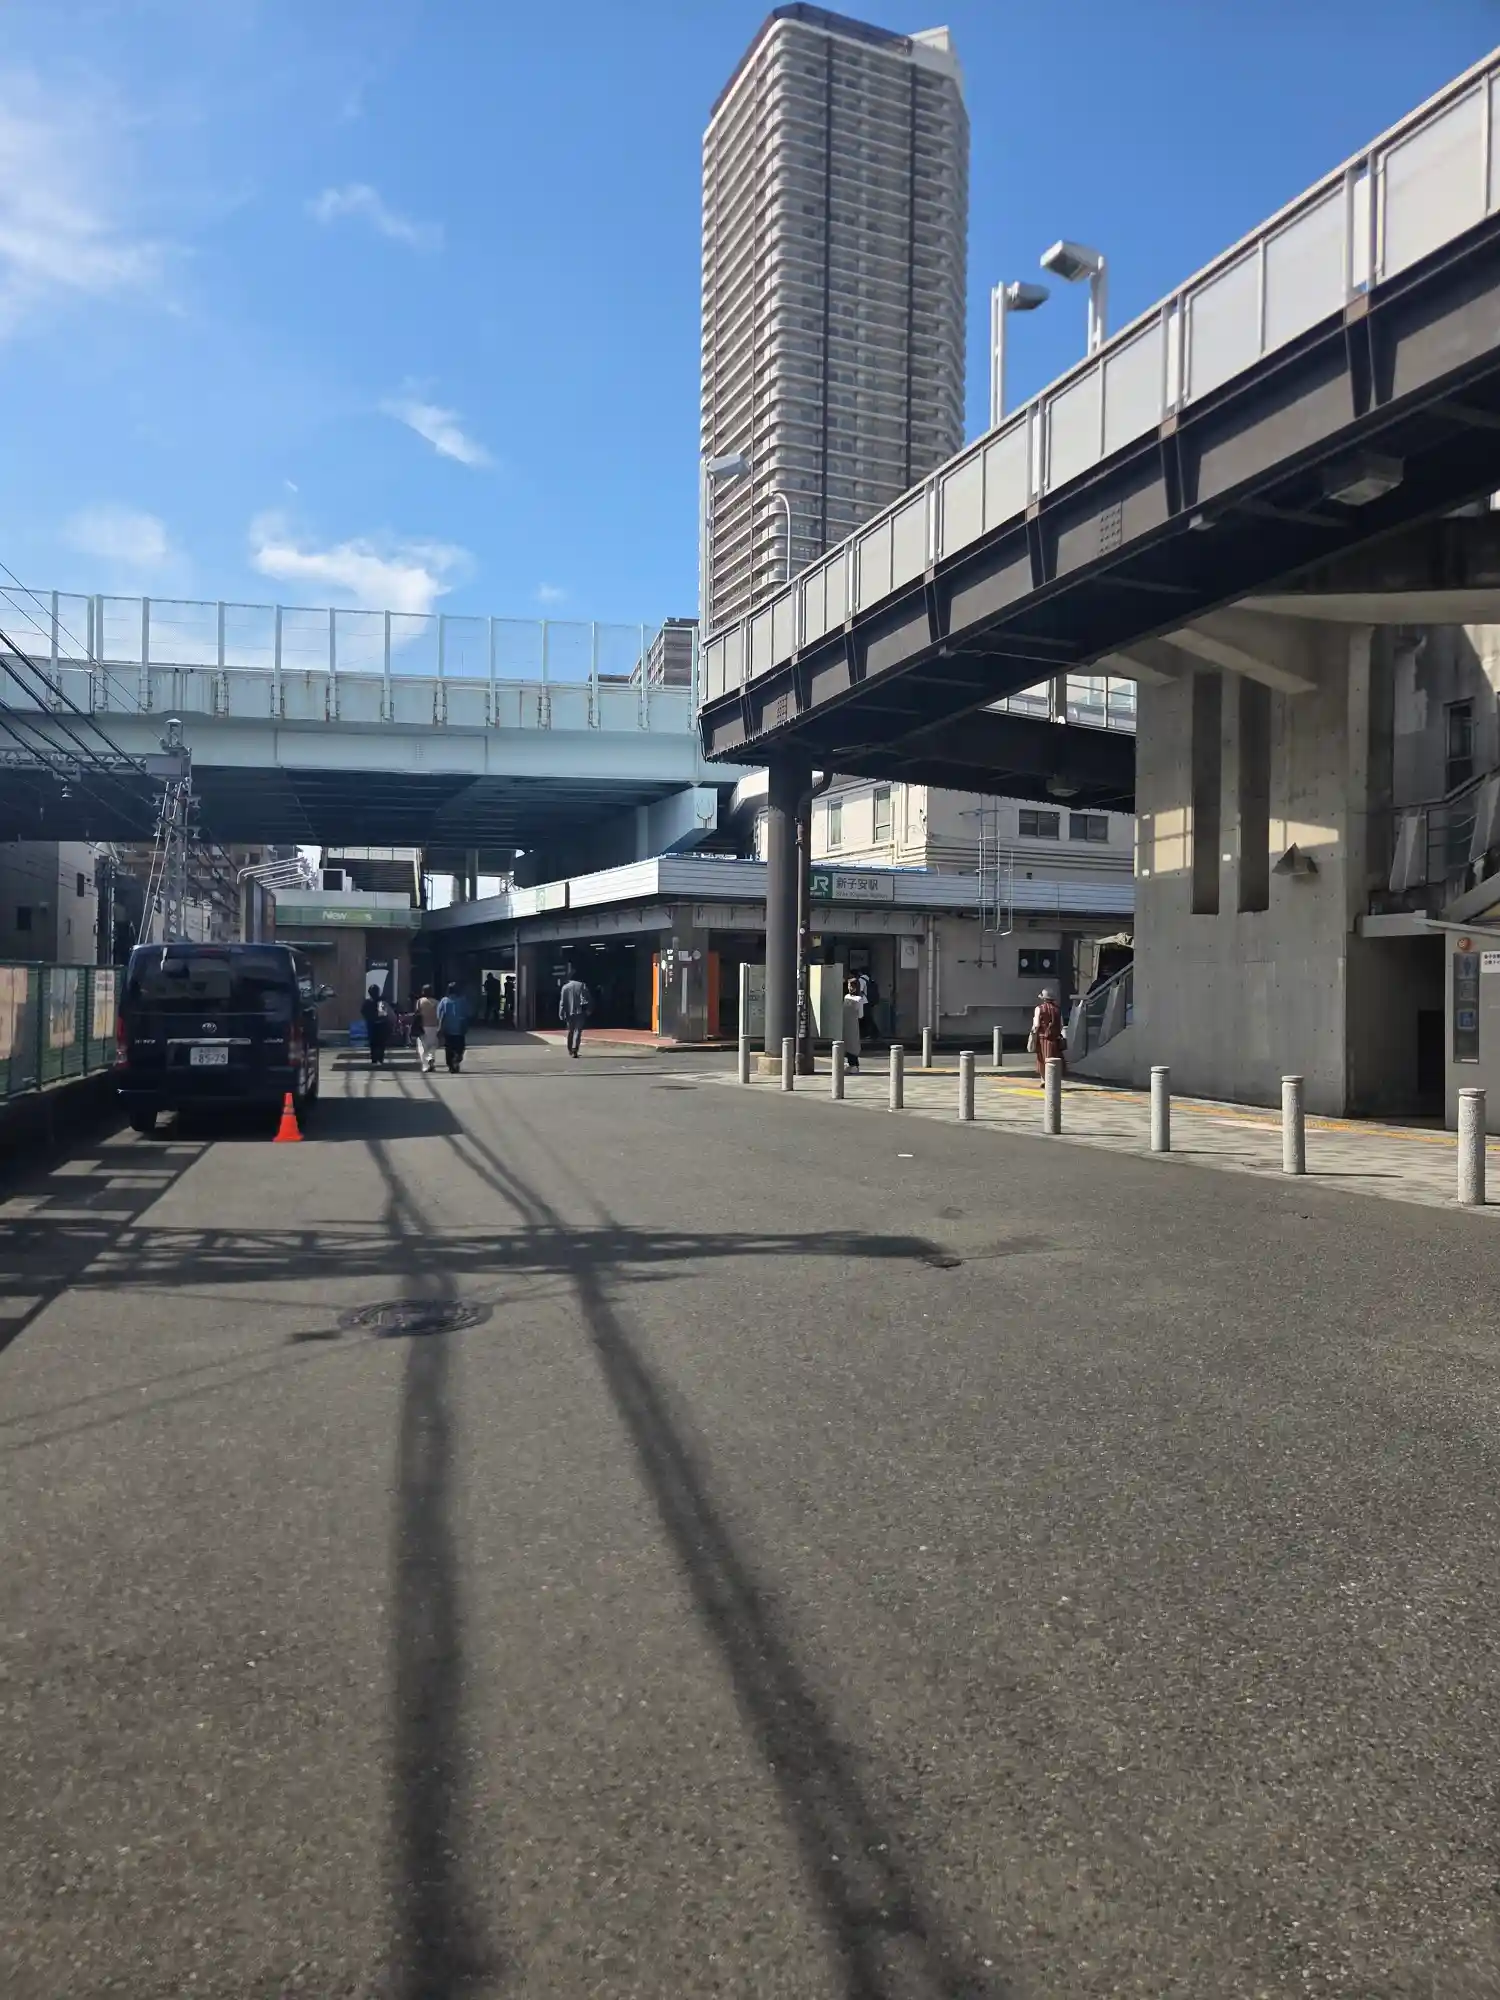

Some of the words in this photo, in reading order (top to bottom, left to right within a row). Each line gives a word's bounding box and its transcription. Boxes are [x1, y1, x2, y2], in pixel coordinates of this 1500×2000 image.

[810, 876, 829, 892] JR
[836, 877, 879, 890] 新子安駅
